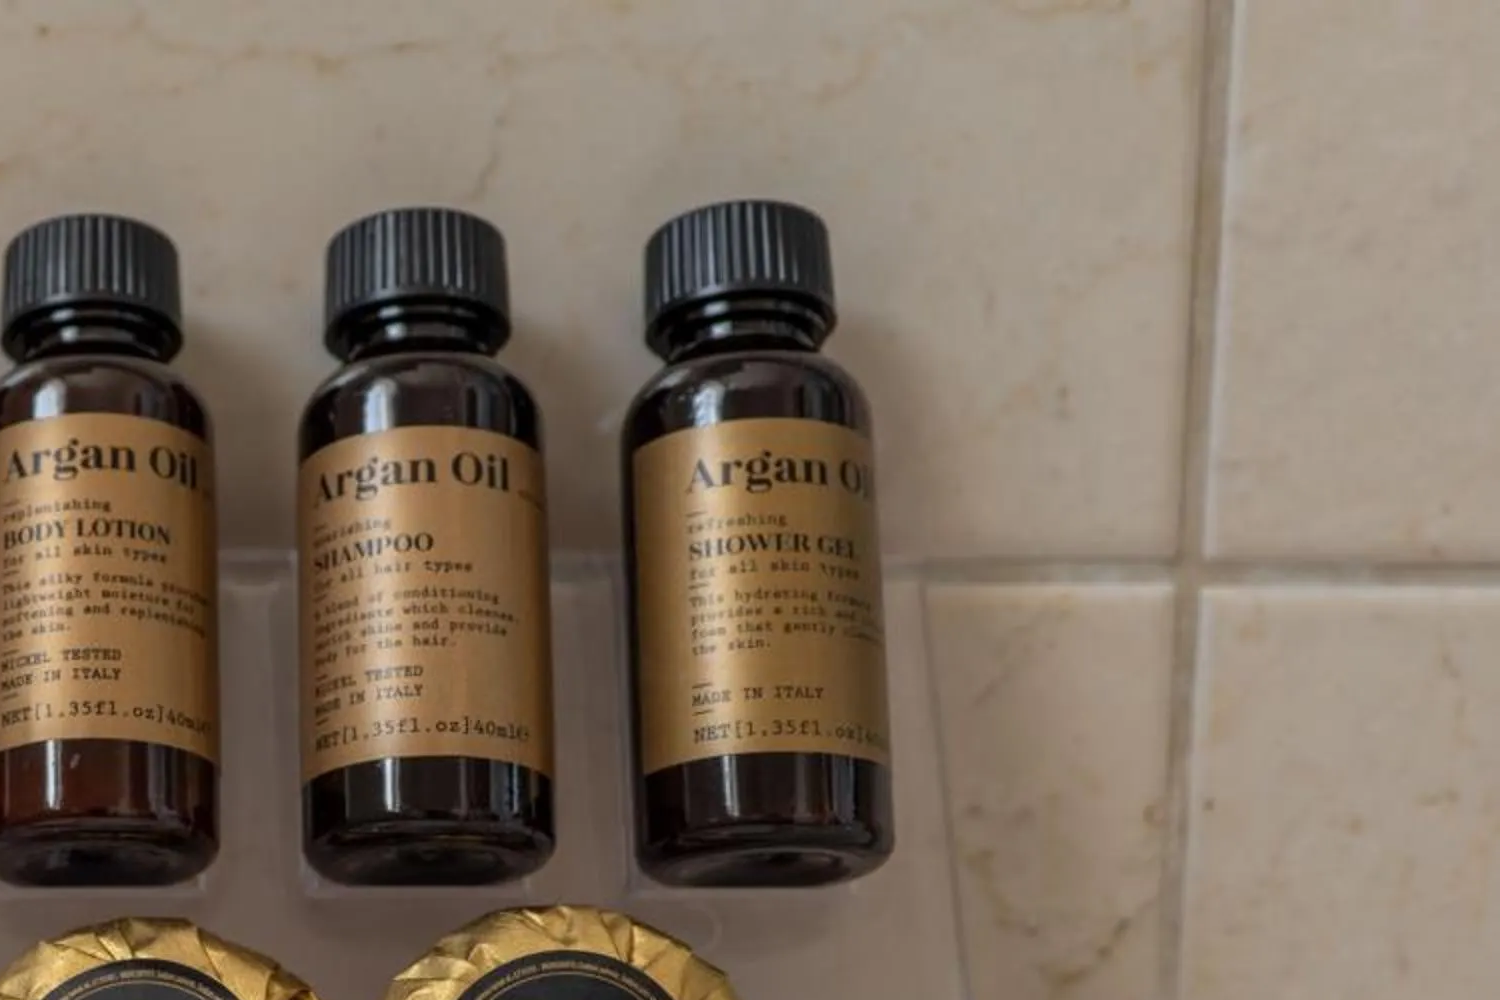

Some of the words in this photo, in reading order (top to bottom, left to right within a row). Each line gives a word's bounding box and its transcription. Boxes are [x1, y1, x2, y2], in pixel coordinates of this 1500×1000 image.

[1, 438, 137, 484] Argan
[148, 445, 198, 490] Oil
[685, 450, 828, 494] Argan
[314, 456, 438, 508] Argan
[451, 451, 510, 493] Oil
[2, 498, 112, 523] replenishing
[3, 518, 67, 550] BODY
[76, 517, 171, 545] LOTION
[687, 512, 788, 534] refreshing
[2, 555, 26, 570] for
[34, 546, 61, 561] all
[73, 543, 113, 557] skin
[123, 546, 168, 564] types
[314, 531, 435, 573] SHAMPOO
[689, 532, 811, 561] SHOWER
[817, 535, 857, 560] GEL
[423, 560, 474, 574] types
[729, 558, 758, 574] all
[771, 558, 810, 572] skin
[92, 571, 154, 587] formula
[393, 585, 501, 607] conditioning
[83, 602, 111, 615] and
[402, 602, 449, 616] which
[412, 618, 440, 631] and
[449, 620, 508, 638] provide
[0, 652, 51, 674] NICKEL
[62, 647, 123, 661] TESTED
[0, 674, 34, 691] MADE
[43, 668, 62, 683] IN
[72, 667, 123, 680] ITALY
[364, 664, 424, 683] TESTED
[349, 691, 366, 705] IN
[375, 684, 424, 701] ITALY
[692, 689, 731, 708] MADE
[743, 686, 764, 701] IN
[773, 685, 825, 700] ITALY
